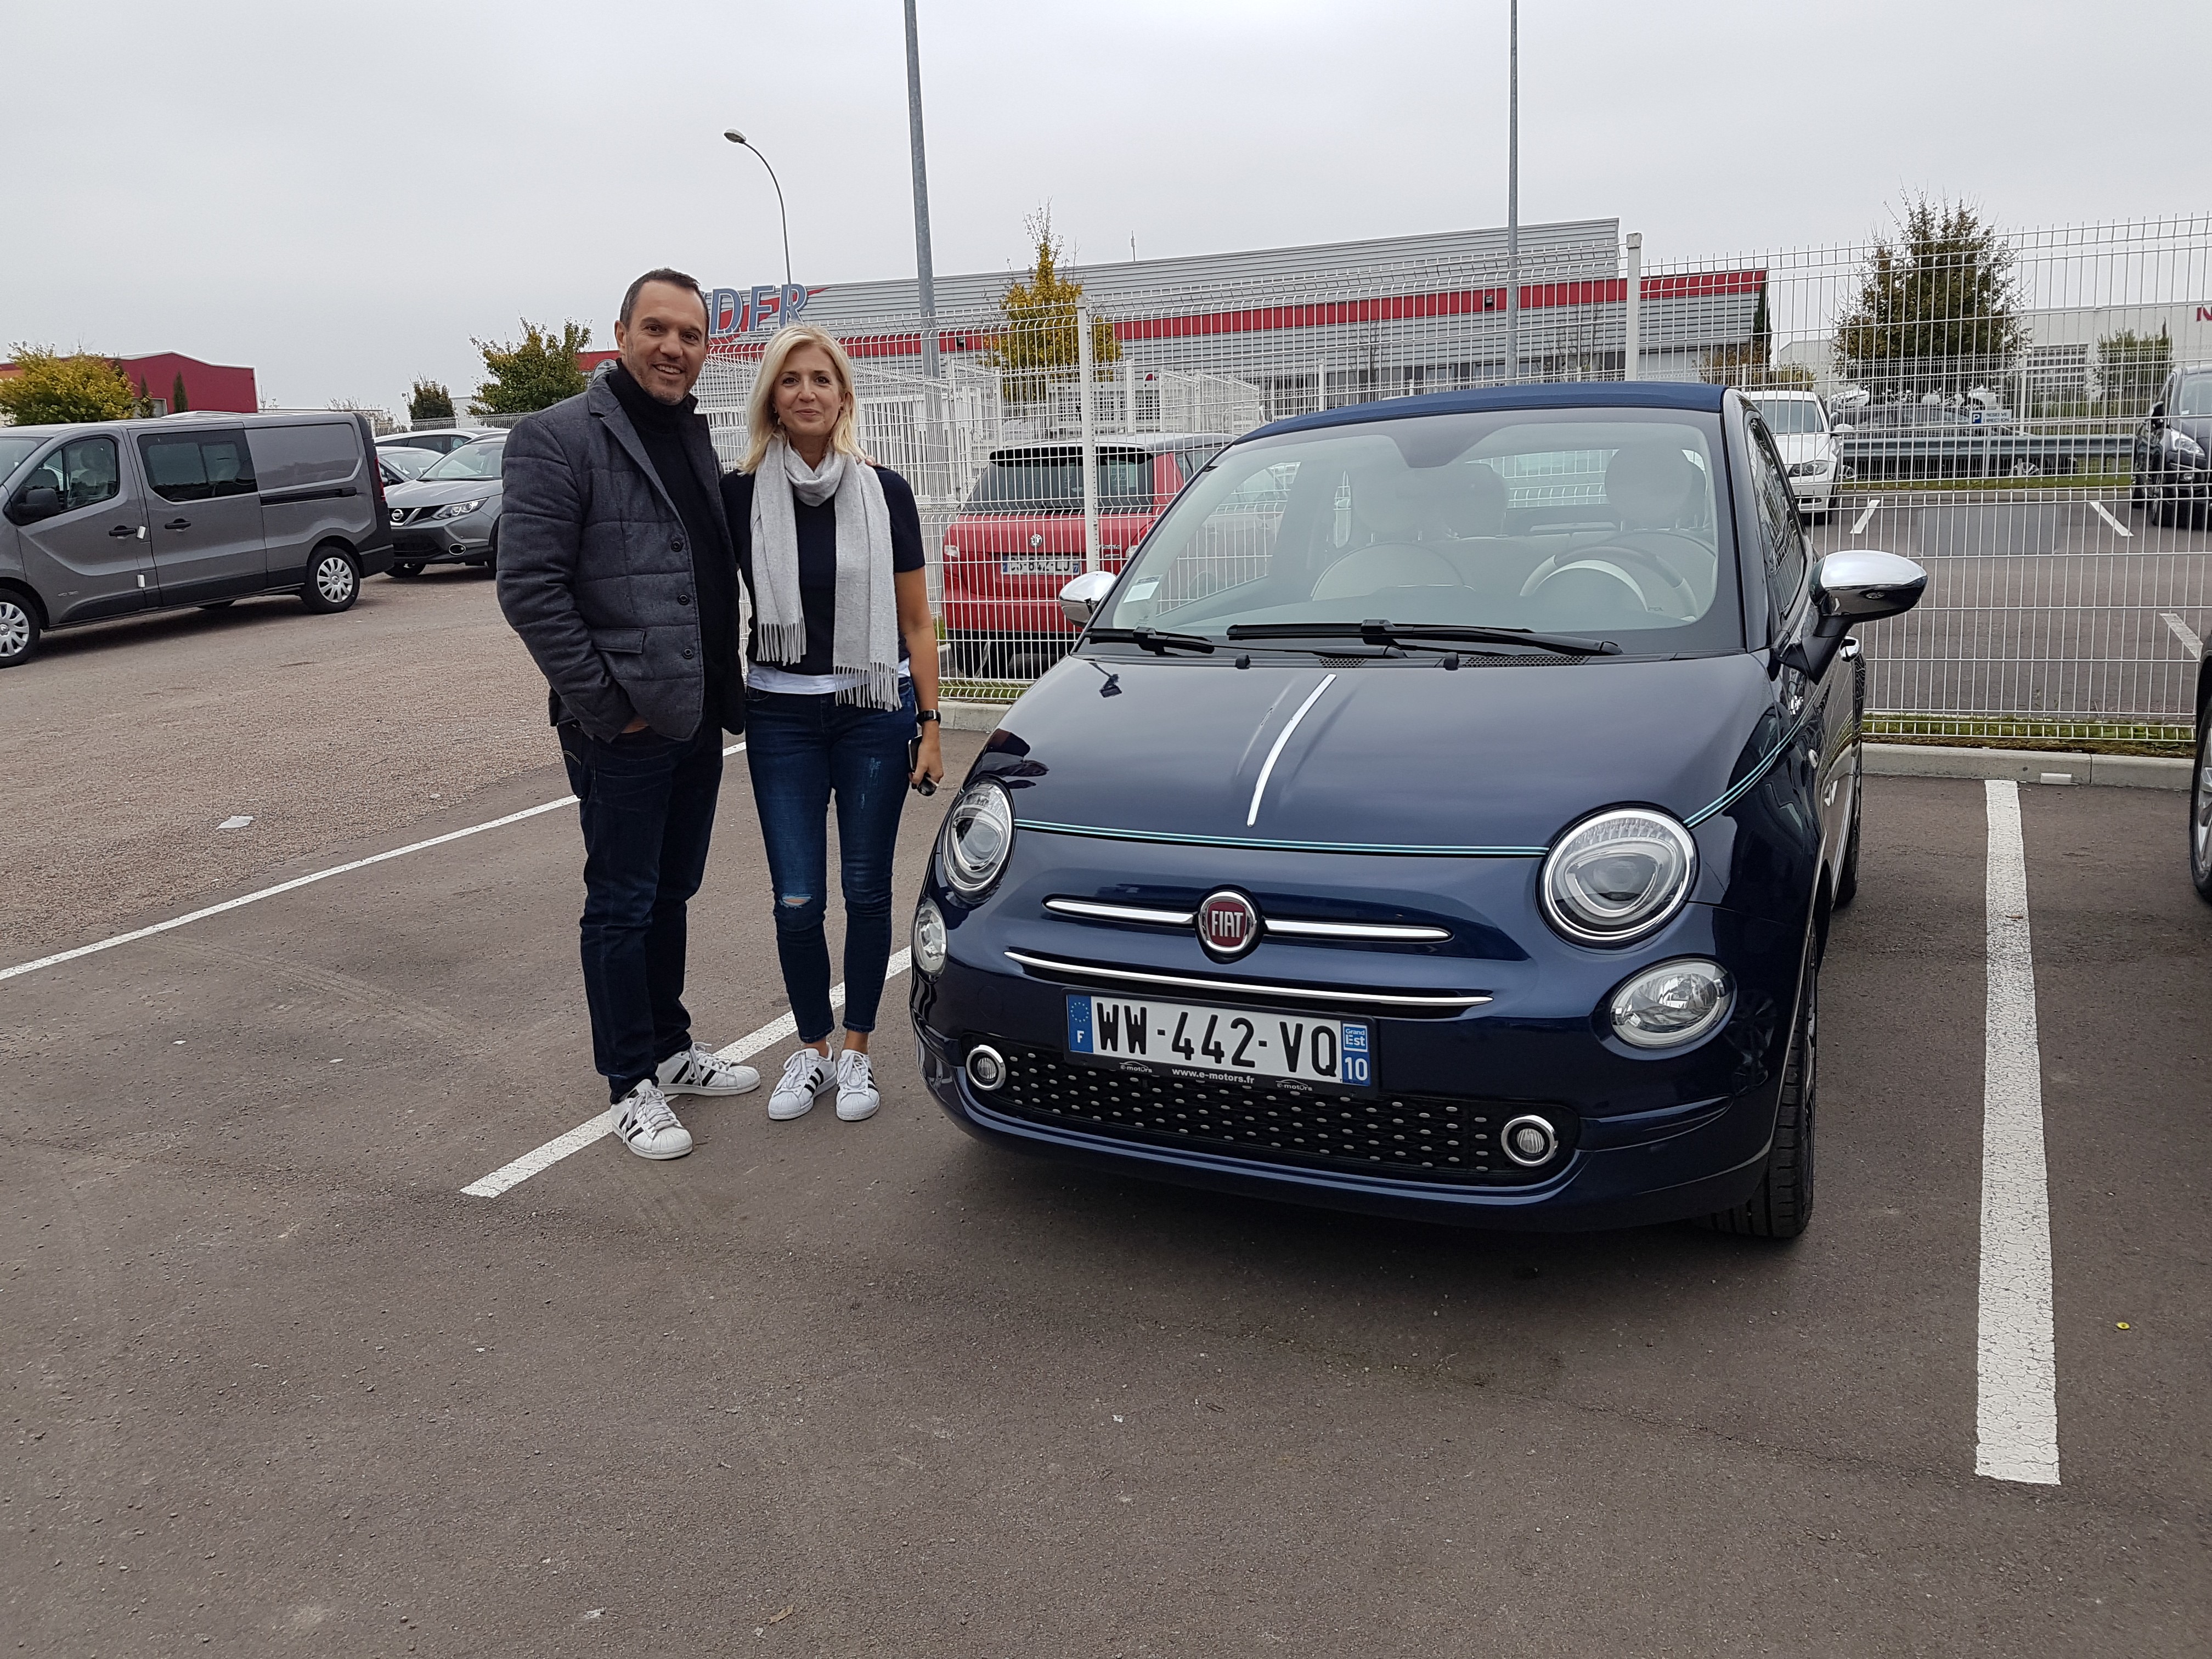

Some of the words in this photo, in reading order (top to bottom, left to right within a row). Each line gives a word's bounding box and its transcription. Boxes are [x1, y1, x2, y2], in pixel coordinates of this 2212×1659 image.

[702, 284, 808, 336] DER
[1973, 414, 1980, 422] P
[1211, 910, 1244, 938] FIAT
[1077, 1030, 1085, 1043] F
[1096, 1002, 1337, 1077] WW-442-VQ
[1345, 1034, 1365, 1046] Est
[1171, 1069, 1255, 1084] www.e-motors.fr
[1345, 1057, 1368, 1081] 10
